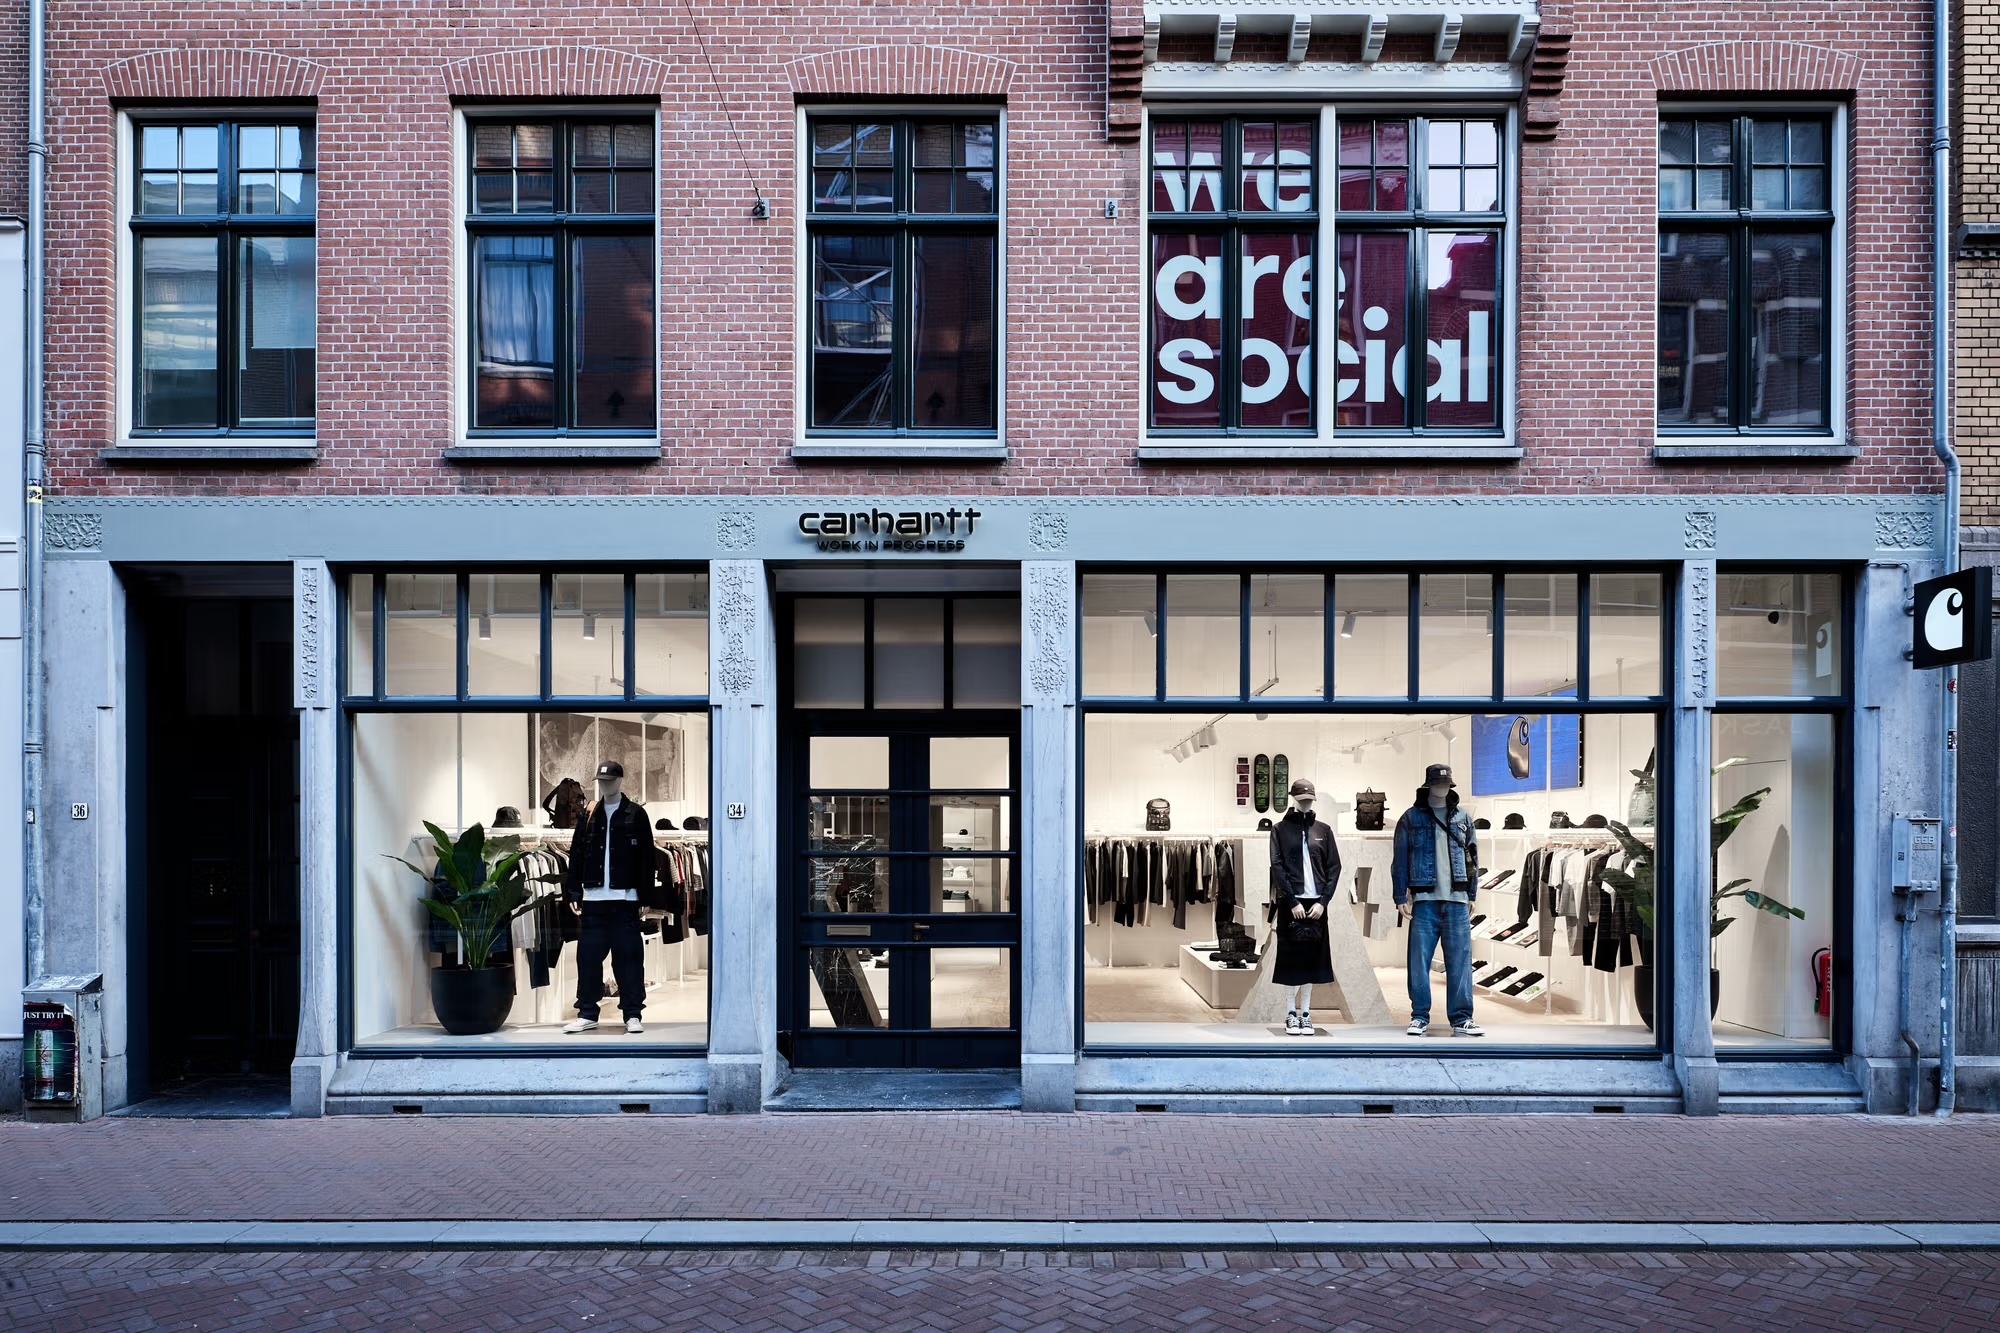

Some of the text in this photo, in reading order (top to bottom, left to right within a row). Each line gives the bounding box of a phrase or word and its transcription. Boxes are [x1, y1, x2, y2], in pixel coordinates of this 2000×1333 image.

[1154, 149, 1311, 212] we
[1157, 306, 1489, 404] social
[799, 507, 982, 535] carhartt
[817, 539, 966, 551] WORK IN PROGRESS
[73, 804, 86, 818] 36
[729, 803, 743, 817] 34
[23, 1011, 41, 1020] JUST
[42, 1011, 56, 1019] TRY
